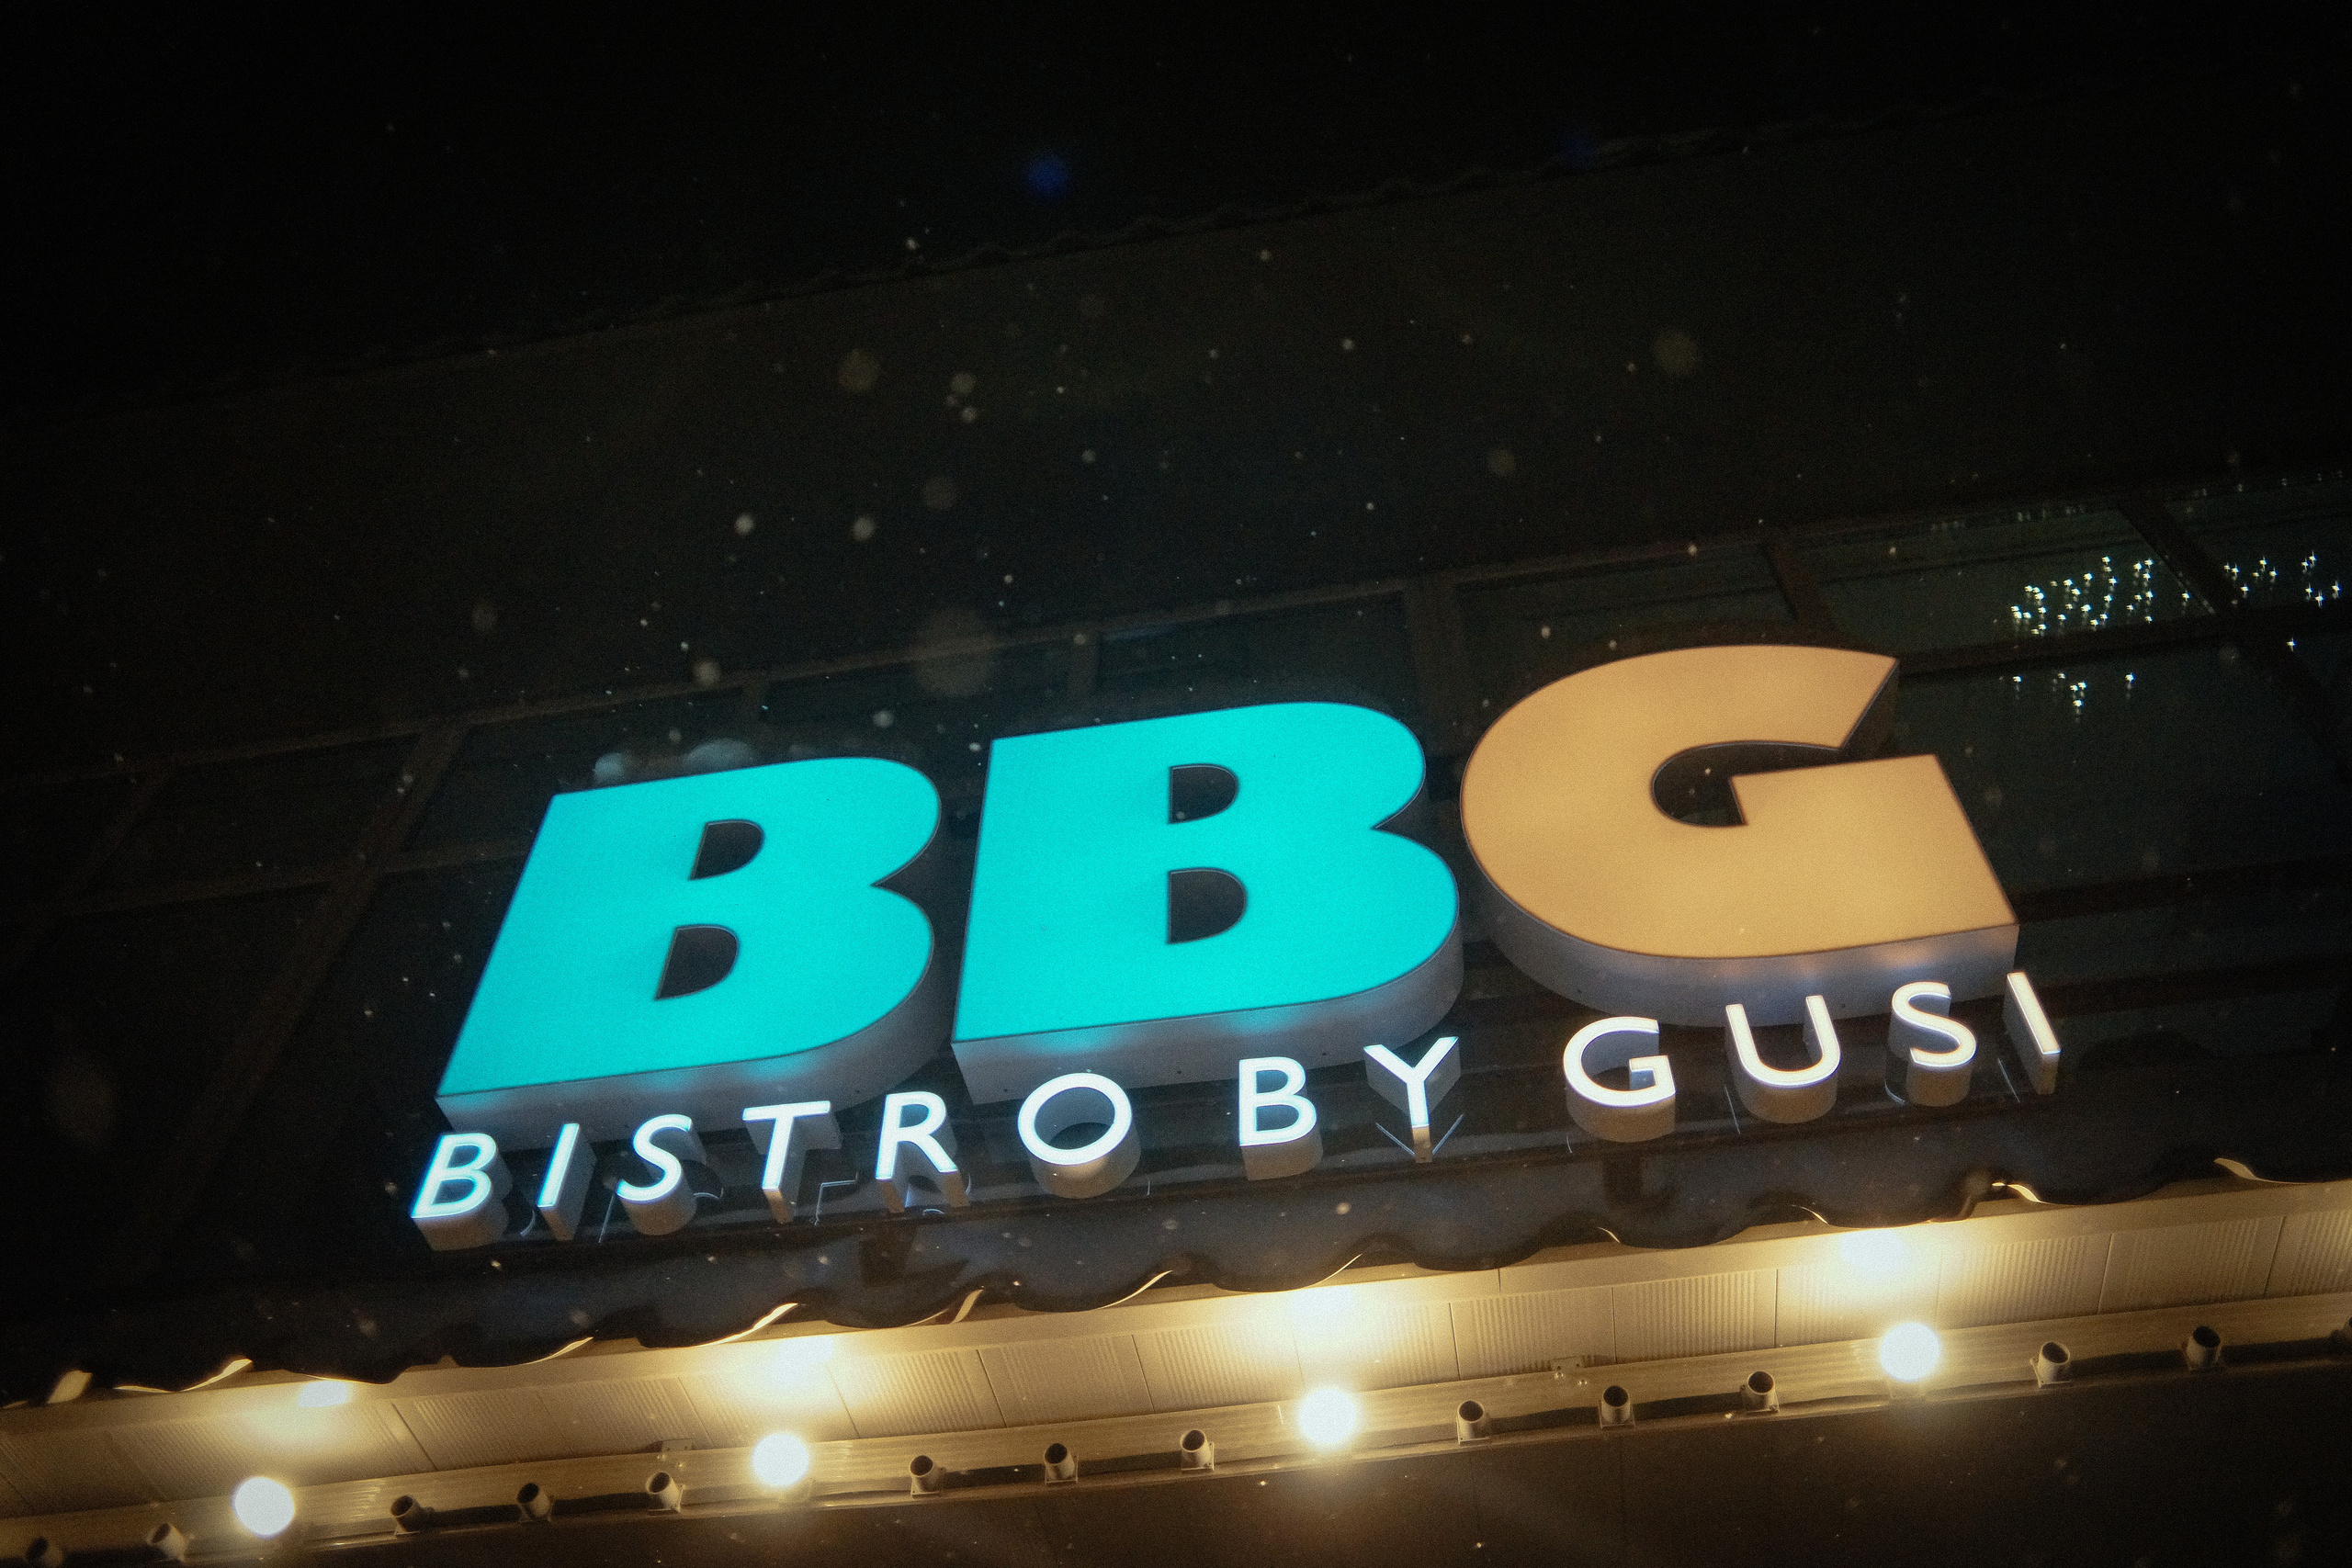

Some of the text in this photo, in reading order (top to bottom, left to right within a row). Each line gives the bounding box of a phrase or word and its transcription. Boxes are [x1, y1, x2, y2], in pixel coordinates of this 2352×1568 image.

[435, 644, 2018, 1097] BBG
[410, 972, 2062, 1219] BISTRO BY GUSI
